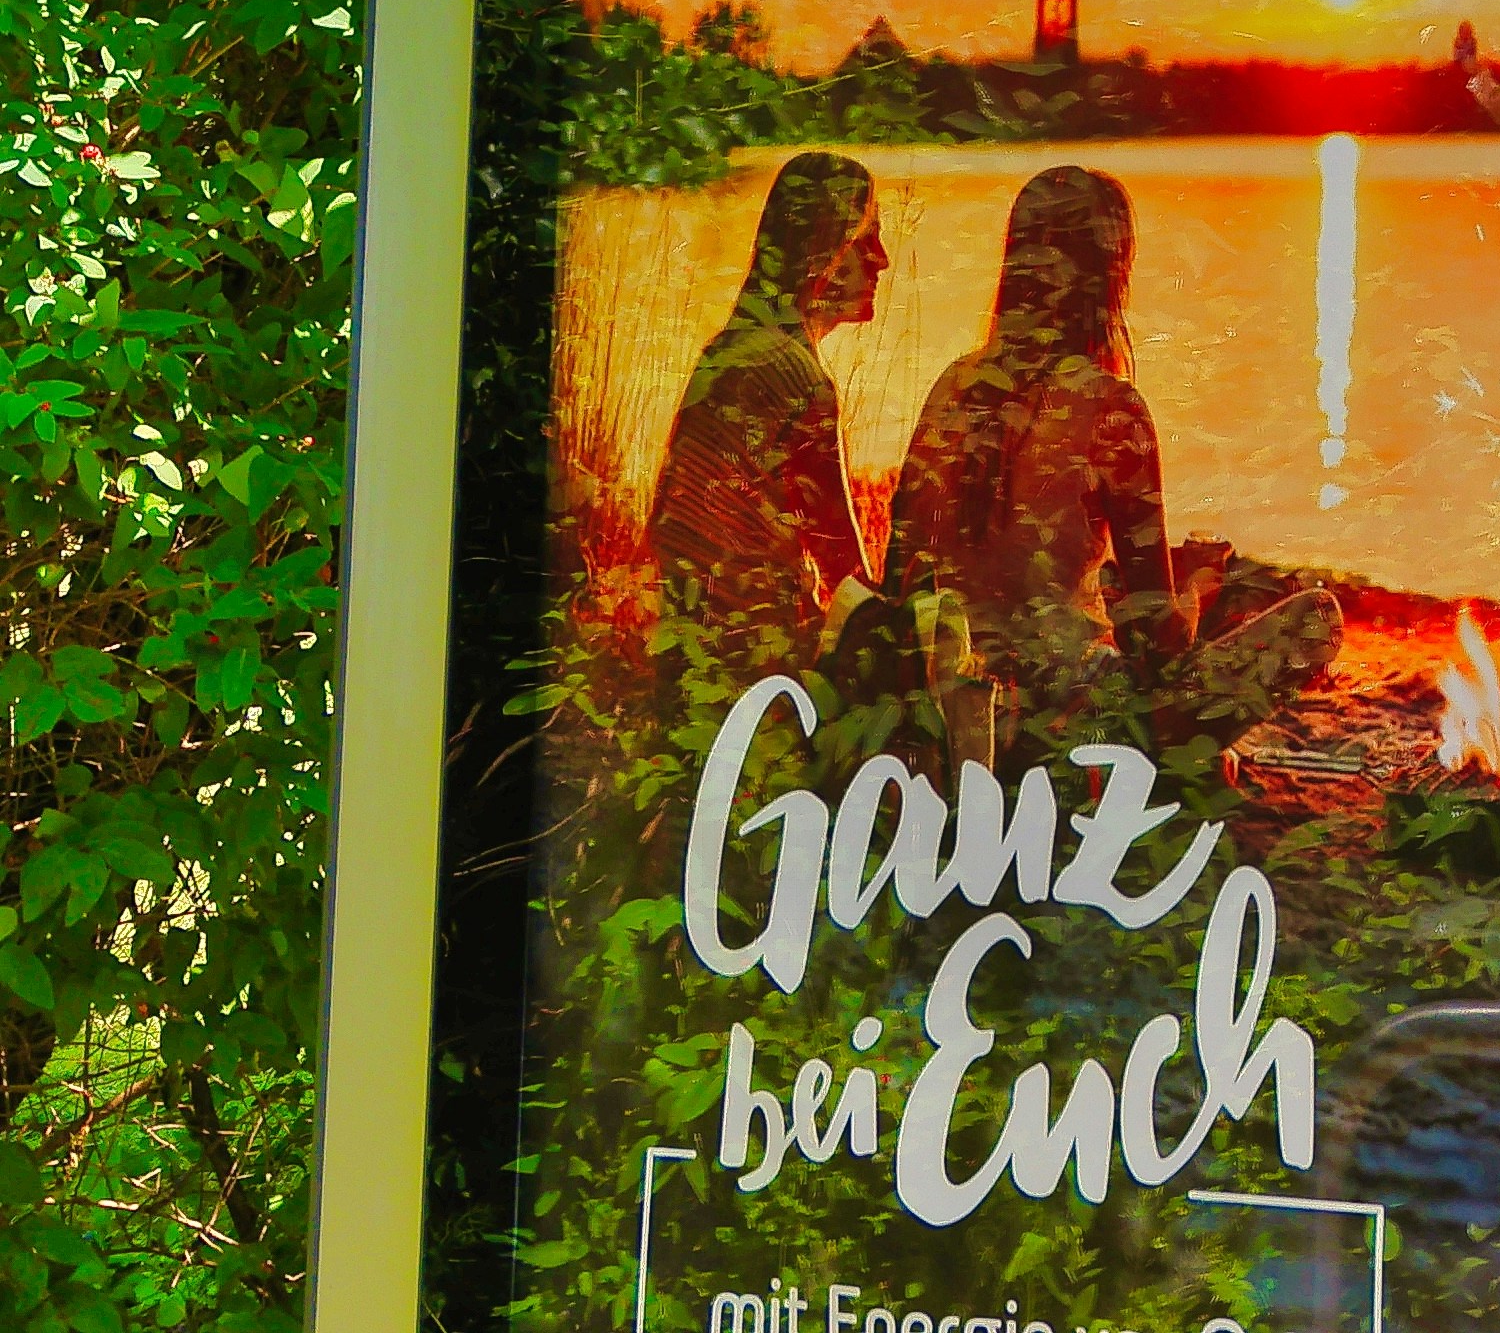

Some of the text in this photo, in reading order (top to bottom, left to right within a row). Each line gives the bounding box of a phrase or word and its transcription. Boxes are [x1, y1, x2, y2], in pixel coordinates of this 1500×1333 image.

[684, 673, 1223, 994] Ganz
[719, 864, 1316, 1227] bei Euch
